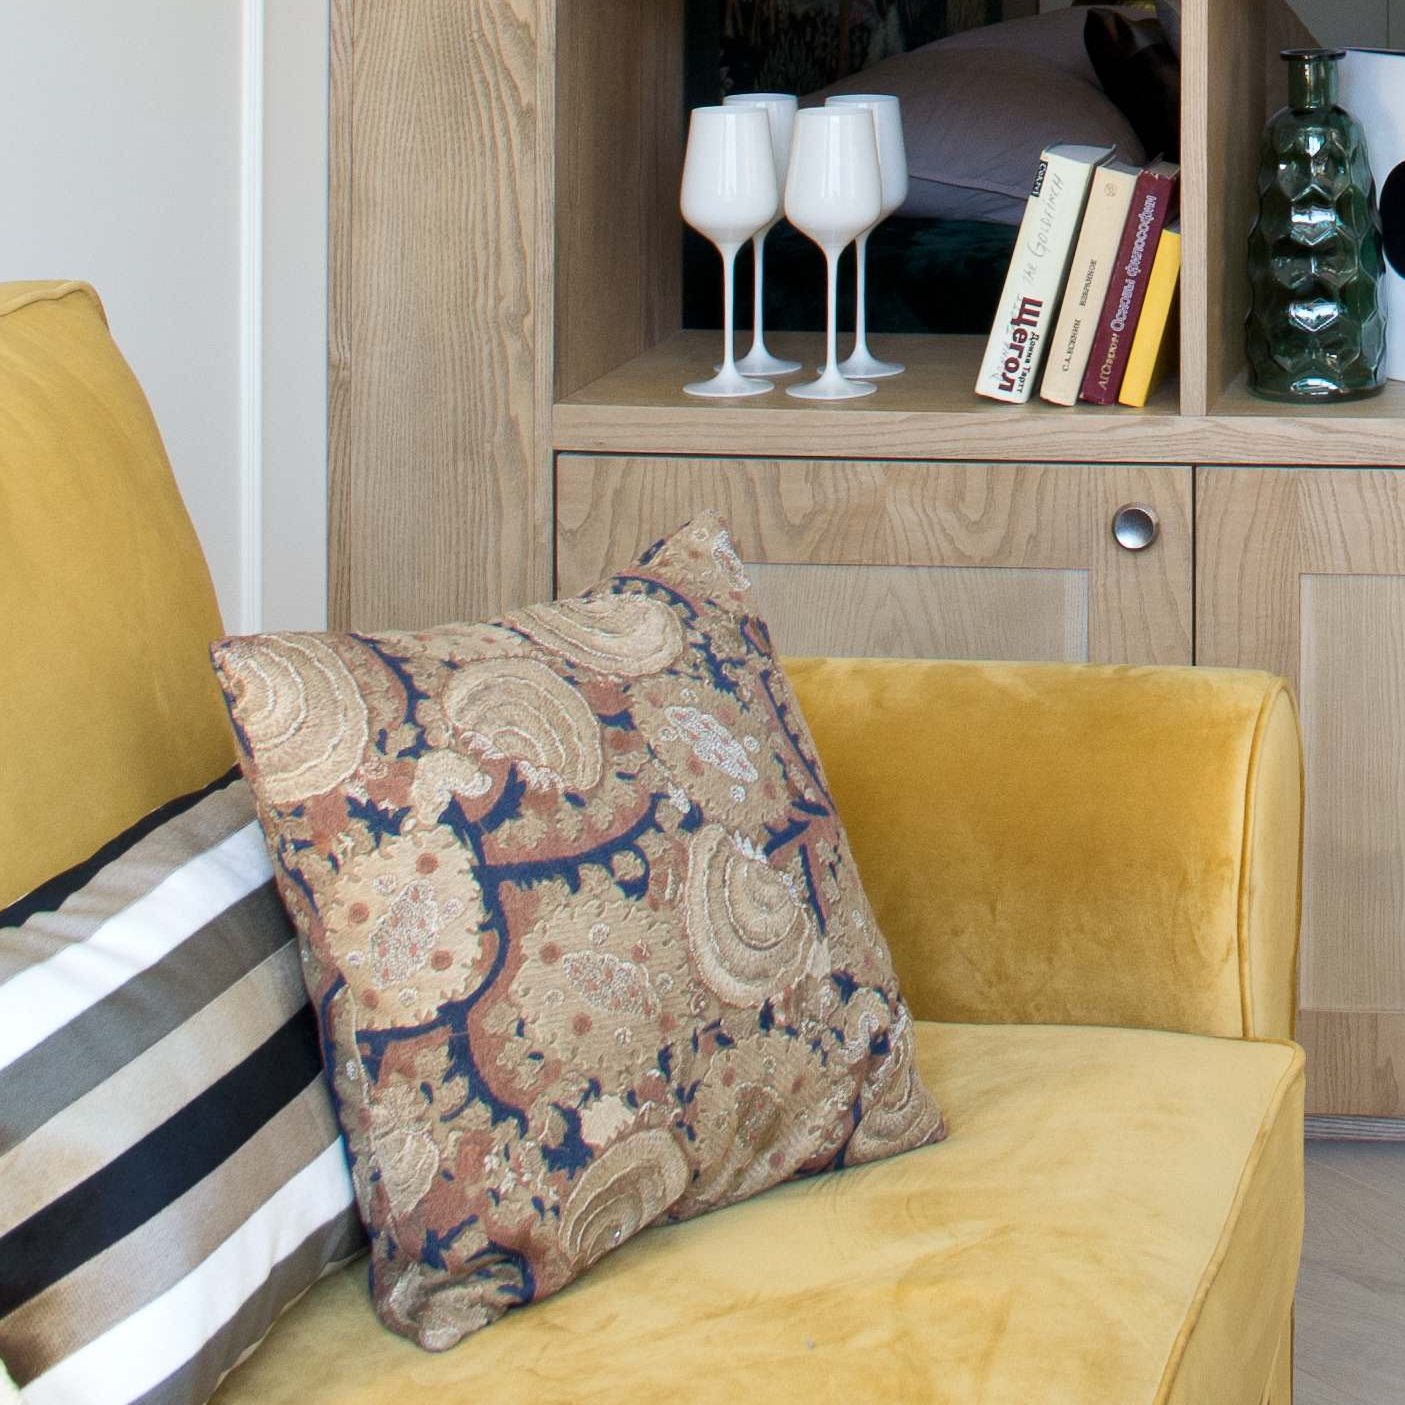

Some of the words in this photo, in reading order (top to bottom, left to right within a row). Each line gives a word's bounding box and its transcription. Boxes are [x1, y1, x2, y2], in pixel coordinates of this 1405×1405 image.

[1079, 258, 1098, 307] ИЗБРАННОЕ
[1110, 279, 1136, 332] Основы
[1124, 194, 1158, 277] философии
[998, 296, 1044, 393] Щегол
[1024, 331, 1040, 364] Донна
